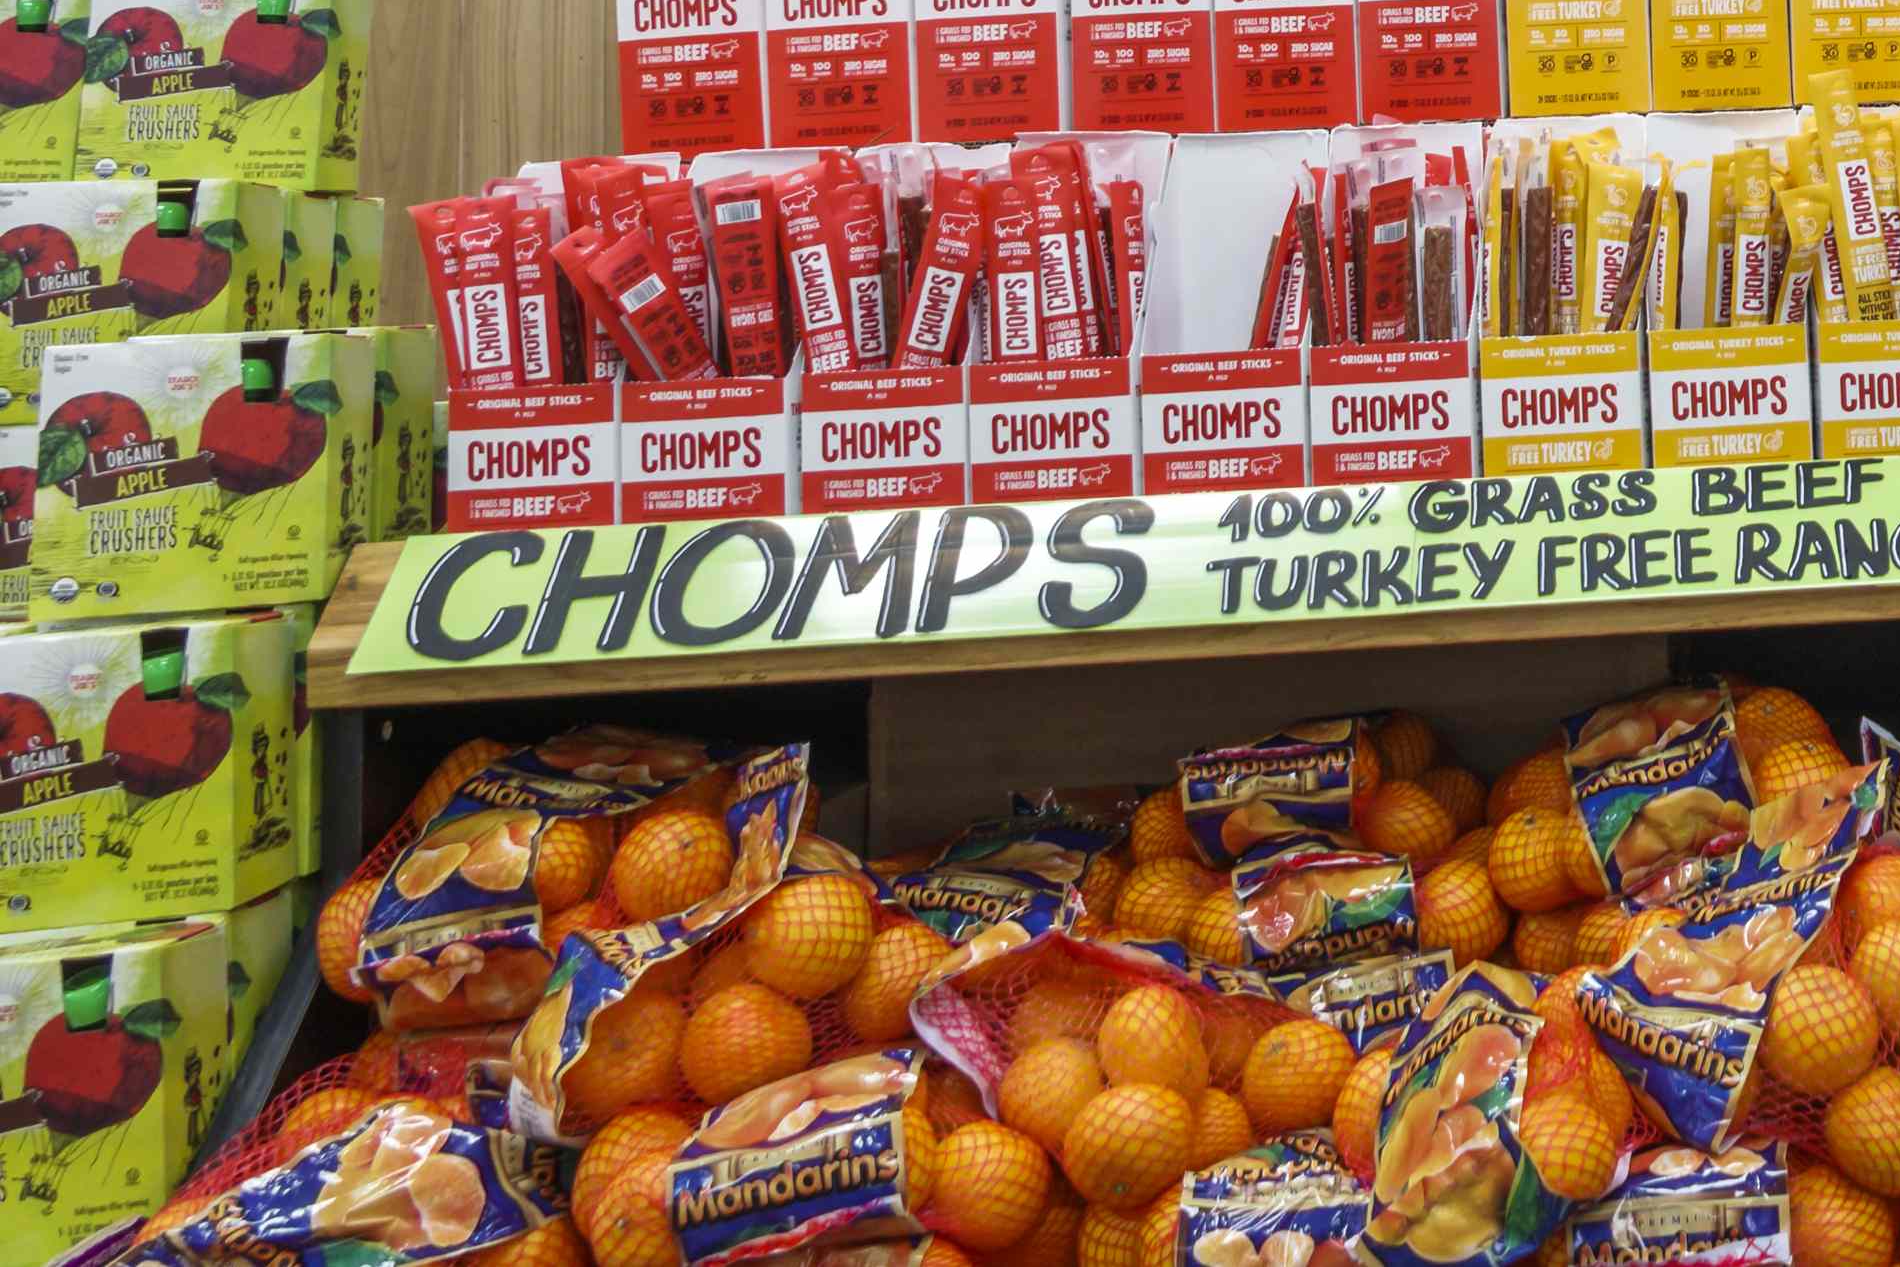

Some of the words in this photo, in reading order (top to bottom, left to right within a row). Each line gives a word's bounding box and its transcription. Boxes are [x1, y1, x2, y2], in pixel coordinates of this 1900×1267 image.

[1271, 15, 1306, 34] BEEF
[1558, 0, 1602, 20] TURKEY
[973, 24, 1009, 42] BEEF
[145, 52, 193, 70] ORGANIC
[674, 43, 709, 61] BEEF
[152, 73, 194, 94] APPLE
[128, 120, 200, 141] CRUSHERS
[1846, 165, 1878, 236] CHOMPS
[807, 251, 837, 325] CHOMPS
[1043, 240, 1073, 313] CHOMPS
[1171, 362, 1214, 373] ORIGINAL
[1218, 361, 1238, 371] BEEF
[1241, 358, 1272, 369] STICKS
[477, 398, 521, 409] ORIGINAL
[525, 396, 546, 407] BEEF
[549, 395, 581, 405] STICKS
[1332, 391, 1449, 435] CHOMPS
[1502, 384, 1617, 428] CHOMPS
[1672, 376, 1787, 420] CHOMPS
[992, 409, 1109, 454] CHOMPS
[1163, 398, 1280, 444] CHOMPS
[106, 442, 165, 467] ORGANIC
[641, 427, 761, 473] CHOMPS
[822, 417, 941, 462] CHOMPS
[1541, 440, 1591, 465] TURKEY
[468, 435, 590, 481] CHOMPS
[1209, 458, 1249, 478] BEEF
[1377, 450, 1418, 470] BEEF
[115, 468, 168, 498] APPLE
[686, 488, 727, 508] BEEF
[513, 496, 556, 517] BEEF
[1218, 486, 1385, 543] 100%
[1408, 472, 1656, 533] GRASS
[1691, 458, 1884, 516] BEEF
[90, 510, 128, 527] FRUIT
[135, 506, 178, 526] SAUCE
[90, 525, 177, 555] CRUSHERS
[405, 496, 1156, 662] CHOMPS
[1205, 539, 1515, 614] TURKEY
[1538, 526, 1724, 596] FREE
[1581, 989, 1745, 1087] Mandarins
[677, 1144, 899, 1226] Mandarins
